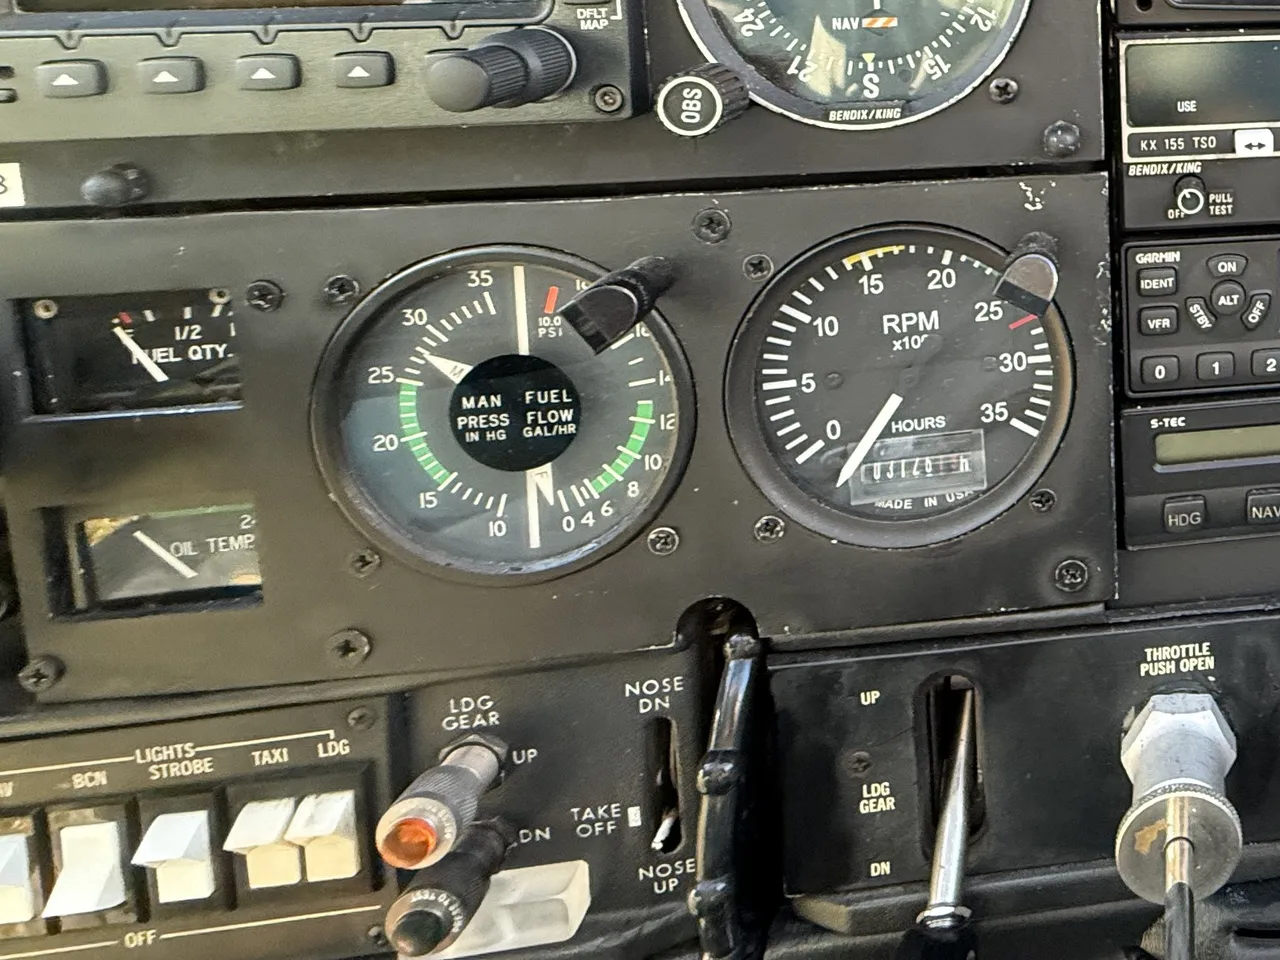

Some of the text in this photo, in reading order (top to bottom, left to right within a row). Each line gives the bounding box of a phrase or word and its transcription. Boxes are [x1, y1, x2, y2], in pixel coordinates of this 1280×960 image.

[832, 18, 859, 30] NAV
[682, 87, 701, 123] OBS
[1178, 101, 1196, 112] USE
[829, 108, 901, 121] BENDIX/KING
[1140, 136, 1217, 151] KX 155 TSO
[1129, 162, 1202, 175] BENDIX/KING
[1209, 194, 1233, 203] PULL
[1209, 205, 1233, 215] TEST
[1136, 251, 1180, 264] GARMIN
[1218, 262, 1236, 272] ON
[1141, 278, 1174, 289] IDENT
[1218, 294, 1239, 306] ALT
[882, 310, 939, 334] RPM
[1148, 319, 1170, 329] VFR
[1189, 303, 1212, 330] STBY
[175, 324, 202, 340] 1/2
[538, 327, 563, 338] PSI
[188, 343, 234, 361] QTY.
[462, 395, 502, 409] MAN
[525, 390, 572, 405] FUEL
[457, 413, 510, 429] PRESS
[526, 409, 574, 424] FLOW
[891, 416, 946, 433] HOURS
[1150, 417, 1186, 428] S-TEC
[466, 430, 507, 443] IN HG
[522, 423, 577, 439] GAL/HR
[1169, 512, 1201, 526] HDG
[170, 534, 255, 557] OIL TEMP
[1144, 643, 1210, 661] THROTTLE
[1140, 656, 1215, 677] PUSH OPEN
[625, 677, 684, 696] NOSE
[450, 695, 494, 713] LDG
[639, 697, 670, 714] DN
[442, 712, 500, 731] GEAR
[135, 743, 196, 763] LIGHTS
[317, 739, 350, 758] LDG
[251, 748, 289, 766] TAXI
[512, 749, 538, 765] UP
[149, 757, 214, 780] STROBE
[862, 782, 890, 798] LDG
[570, 803, 622, 821] TAKE
[859, 797, 895, 814] GEAR
[519, 828, 550, 844] DN
[576, 821, 617, 838] OFF
[639, 859, 696, 881] NOSE
[654, 878, 679, 894] UP
[124, 930, 157, 949] OFF
